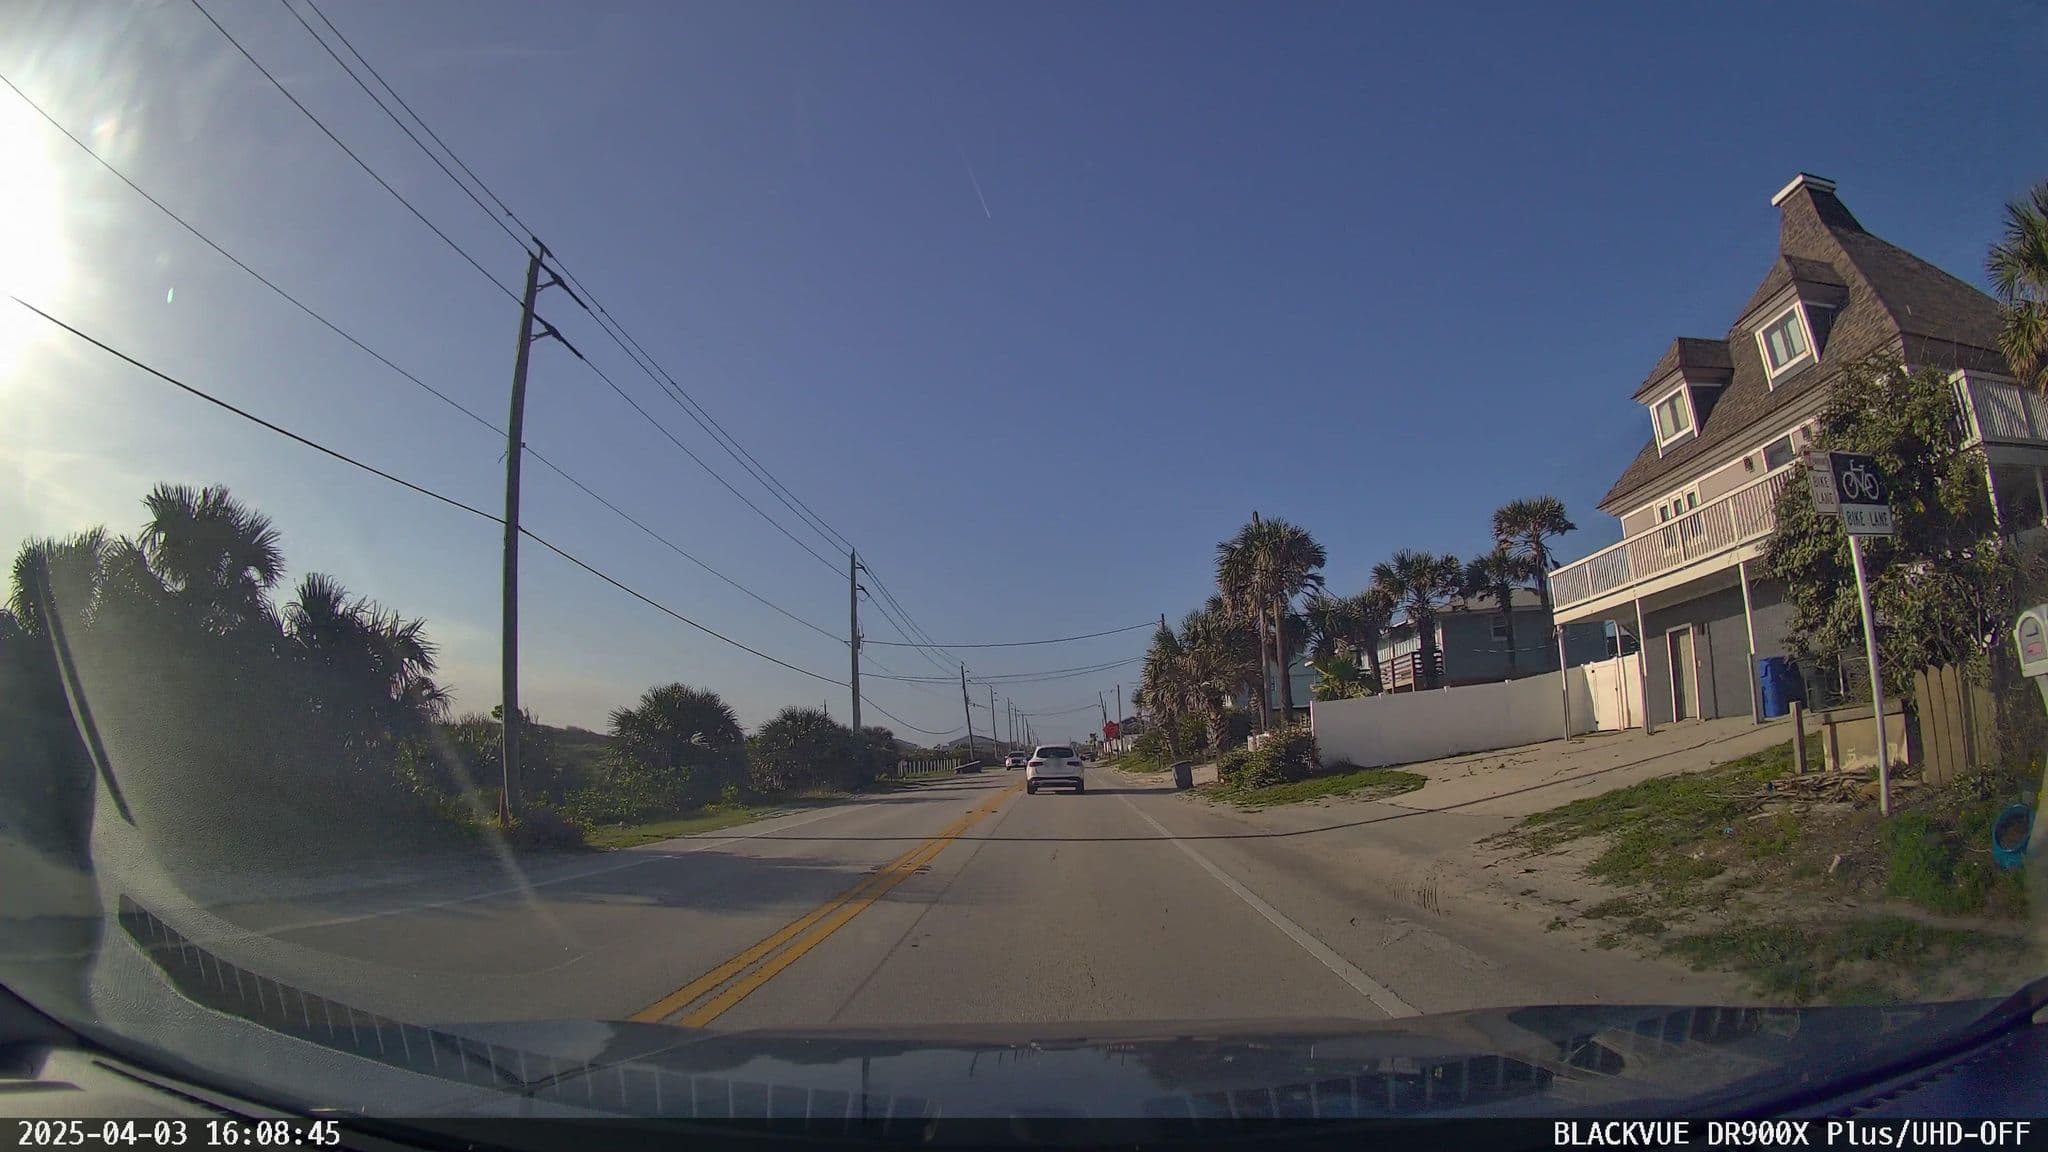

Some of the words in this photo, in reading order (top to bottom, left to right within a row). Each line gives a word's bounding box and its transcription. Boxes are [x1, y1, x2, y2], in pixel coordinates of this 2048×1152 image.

[1812, 475, 1830, 488] BIKE
[1816, 493, 1834, 505] LANE
[1846, 511, 1865, 526] BIKE
[1869, 511, 1888, 526] LANE
